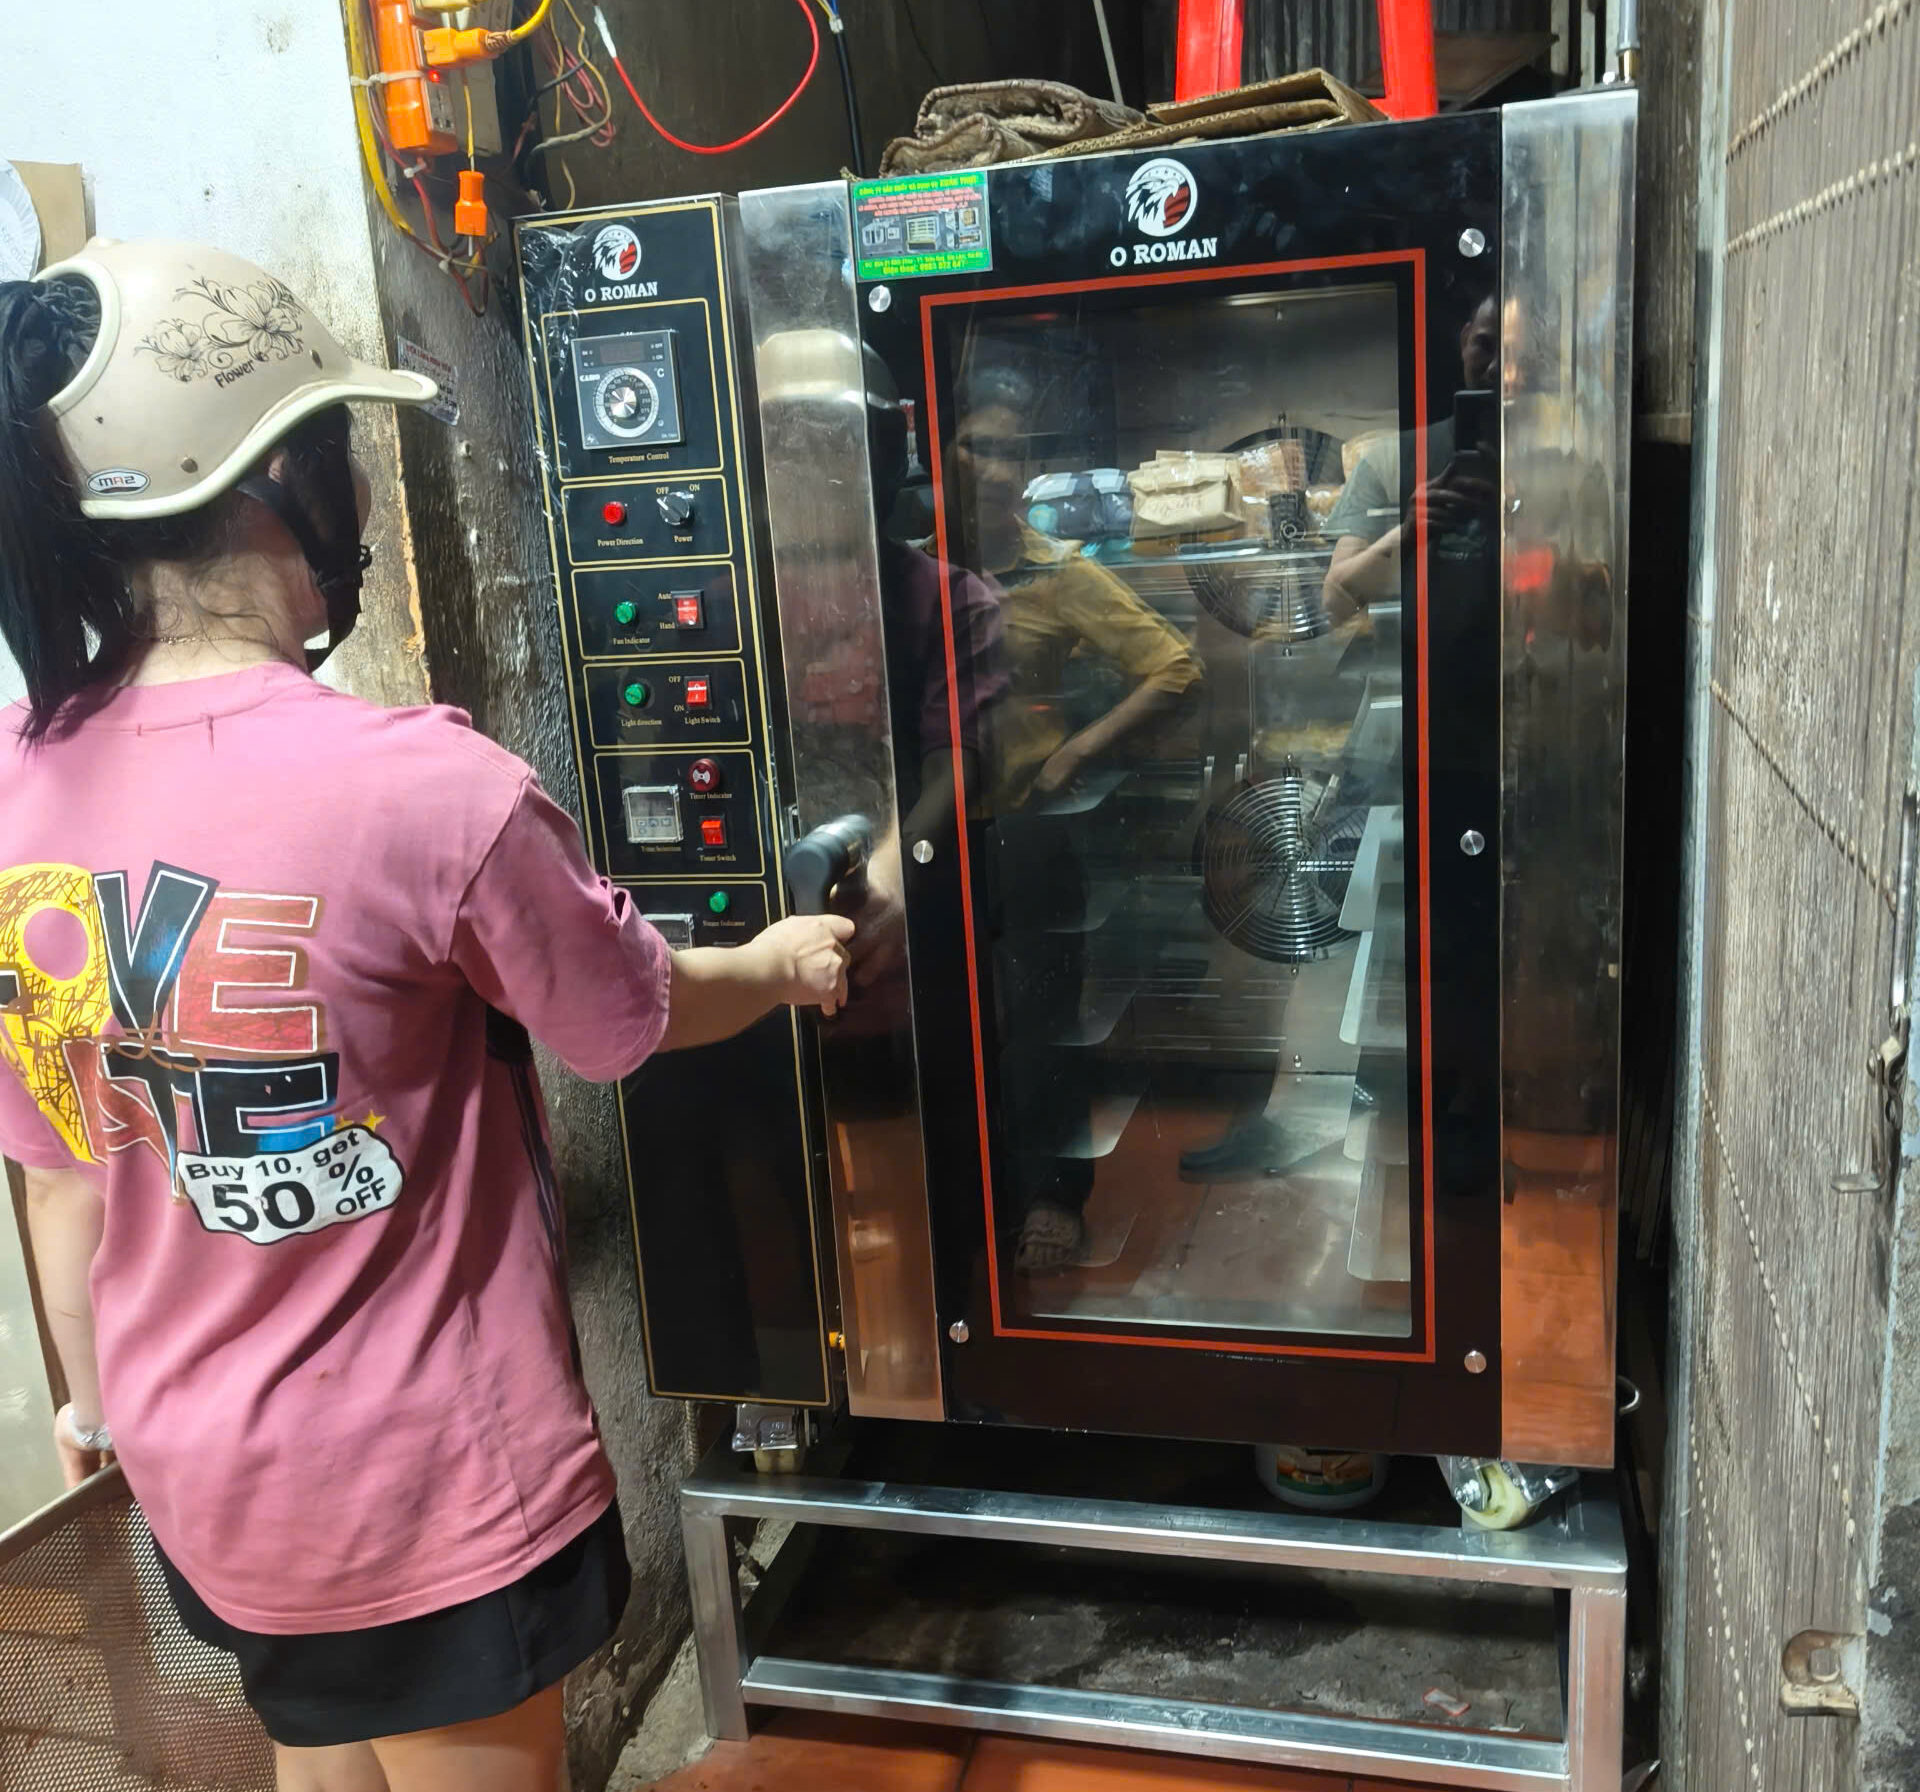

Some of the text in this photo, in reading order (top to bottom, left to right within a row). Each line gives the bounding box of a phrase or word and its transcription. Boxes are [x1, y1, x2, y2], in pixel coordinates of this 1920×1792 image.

[1110, 237, 1217, 267] O ROMAN
[584, 281, 658, 303] O ROMAN
[215, 360, 255, 388] Flower
[608, 451, 669, 464] Temperature Control
[656, 486, 670, 495] OFF
[597, 537, 644, 547] Power Direction
[673, 535, 694, 543] Power
[624, 636, 651, 645] Indicator
[674, 704, 685, 712] ON
[185, 1130, 360, 1181] Buy 10, get
[335, 1177, 386, 1216] OFF
